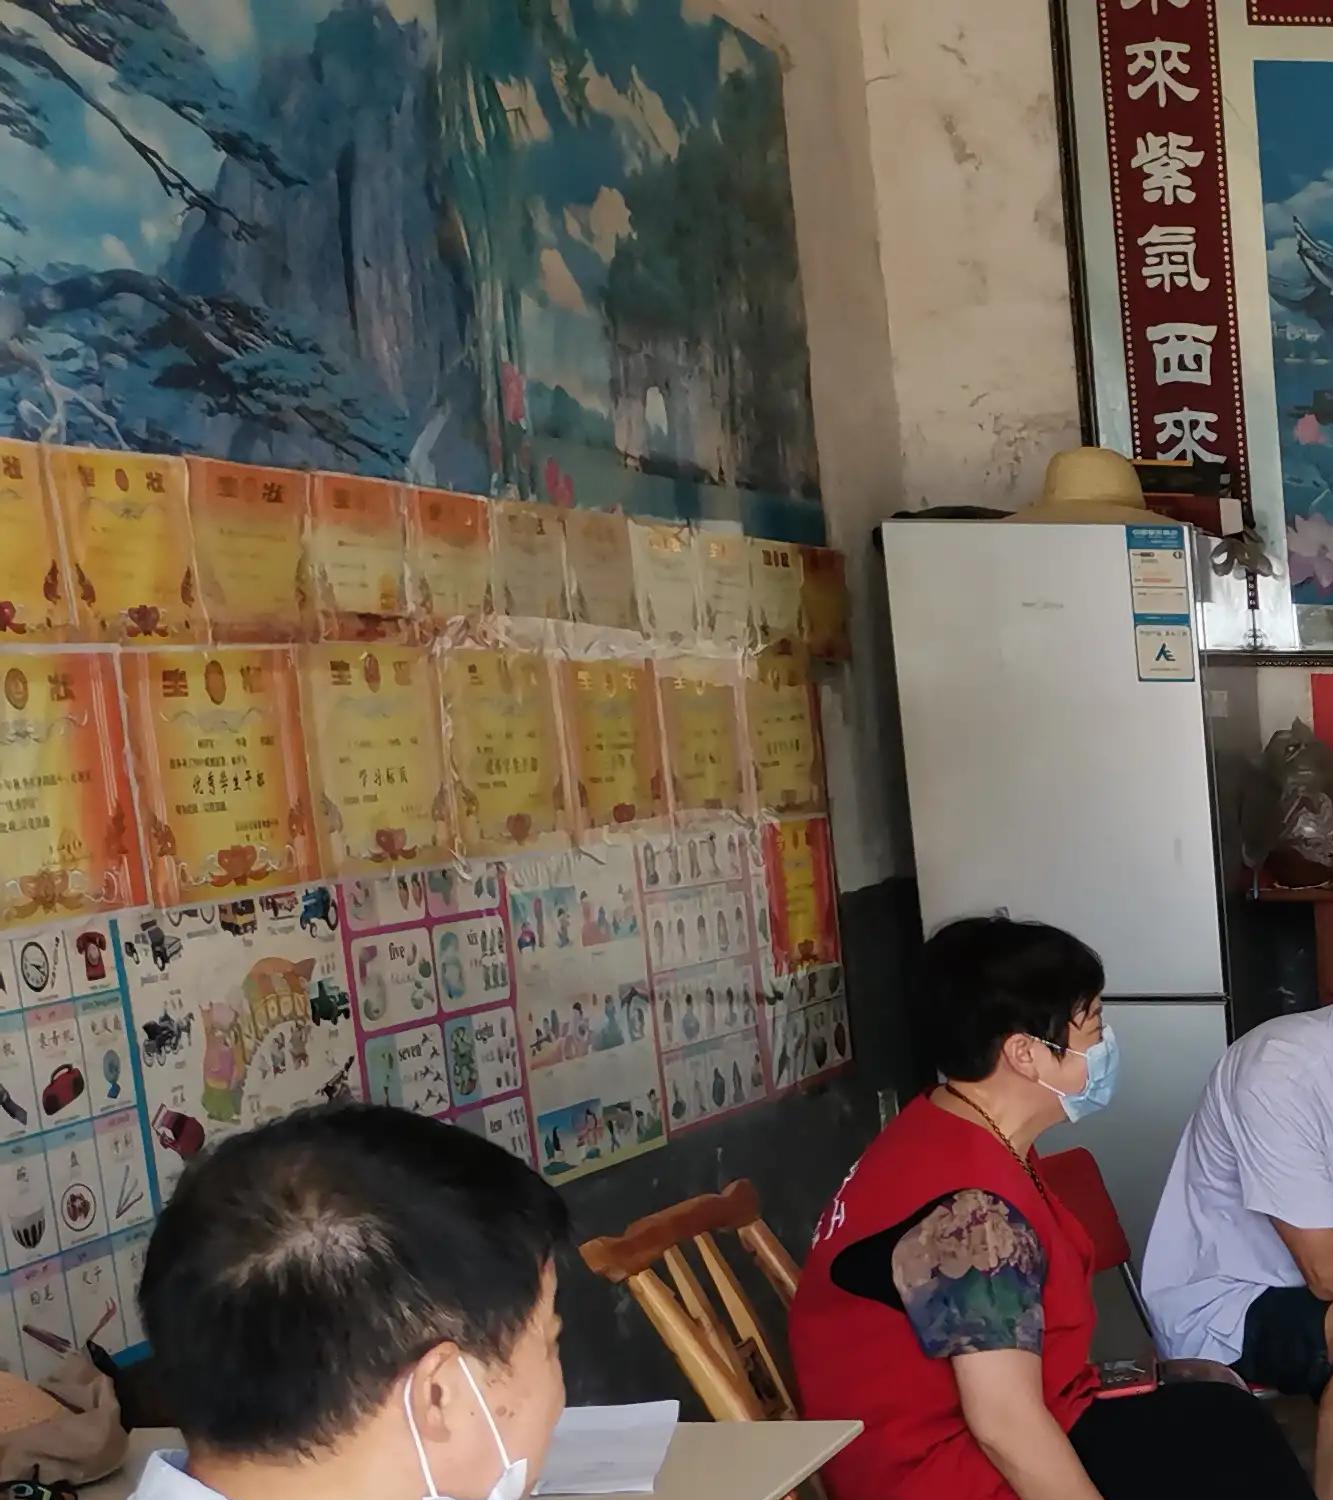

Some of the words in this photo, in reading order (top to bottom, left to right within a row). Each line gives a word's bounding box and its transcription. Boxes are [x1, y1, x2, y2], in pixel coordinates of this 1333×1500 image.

[1118, 0, 1228, 465] 來紫氣西來
[388, 942, 405, 961] five
[398, 1043, 422, 1062] seven
